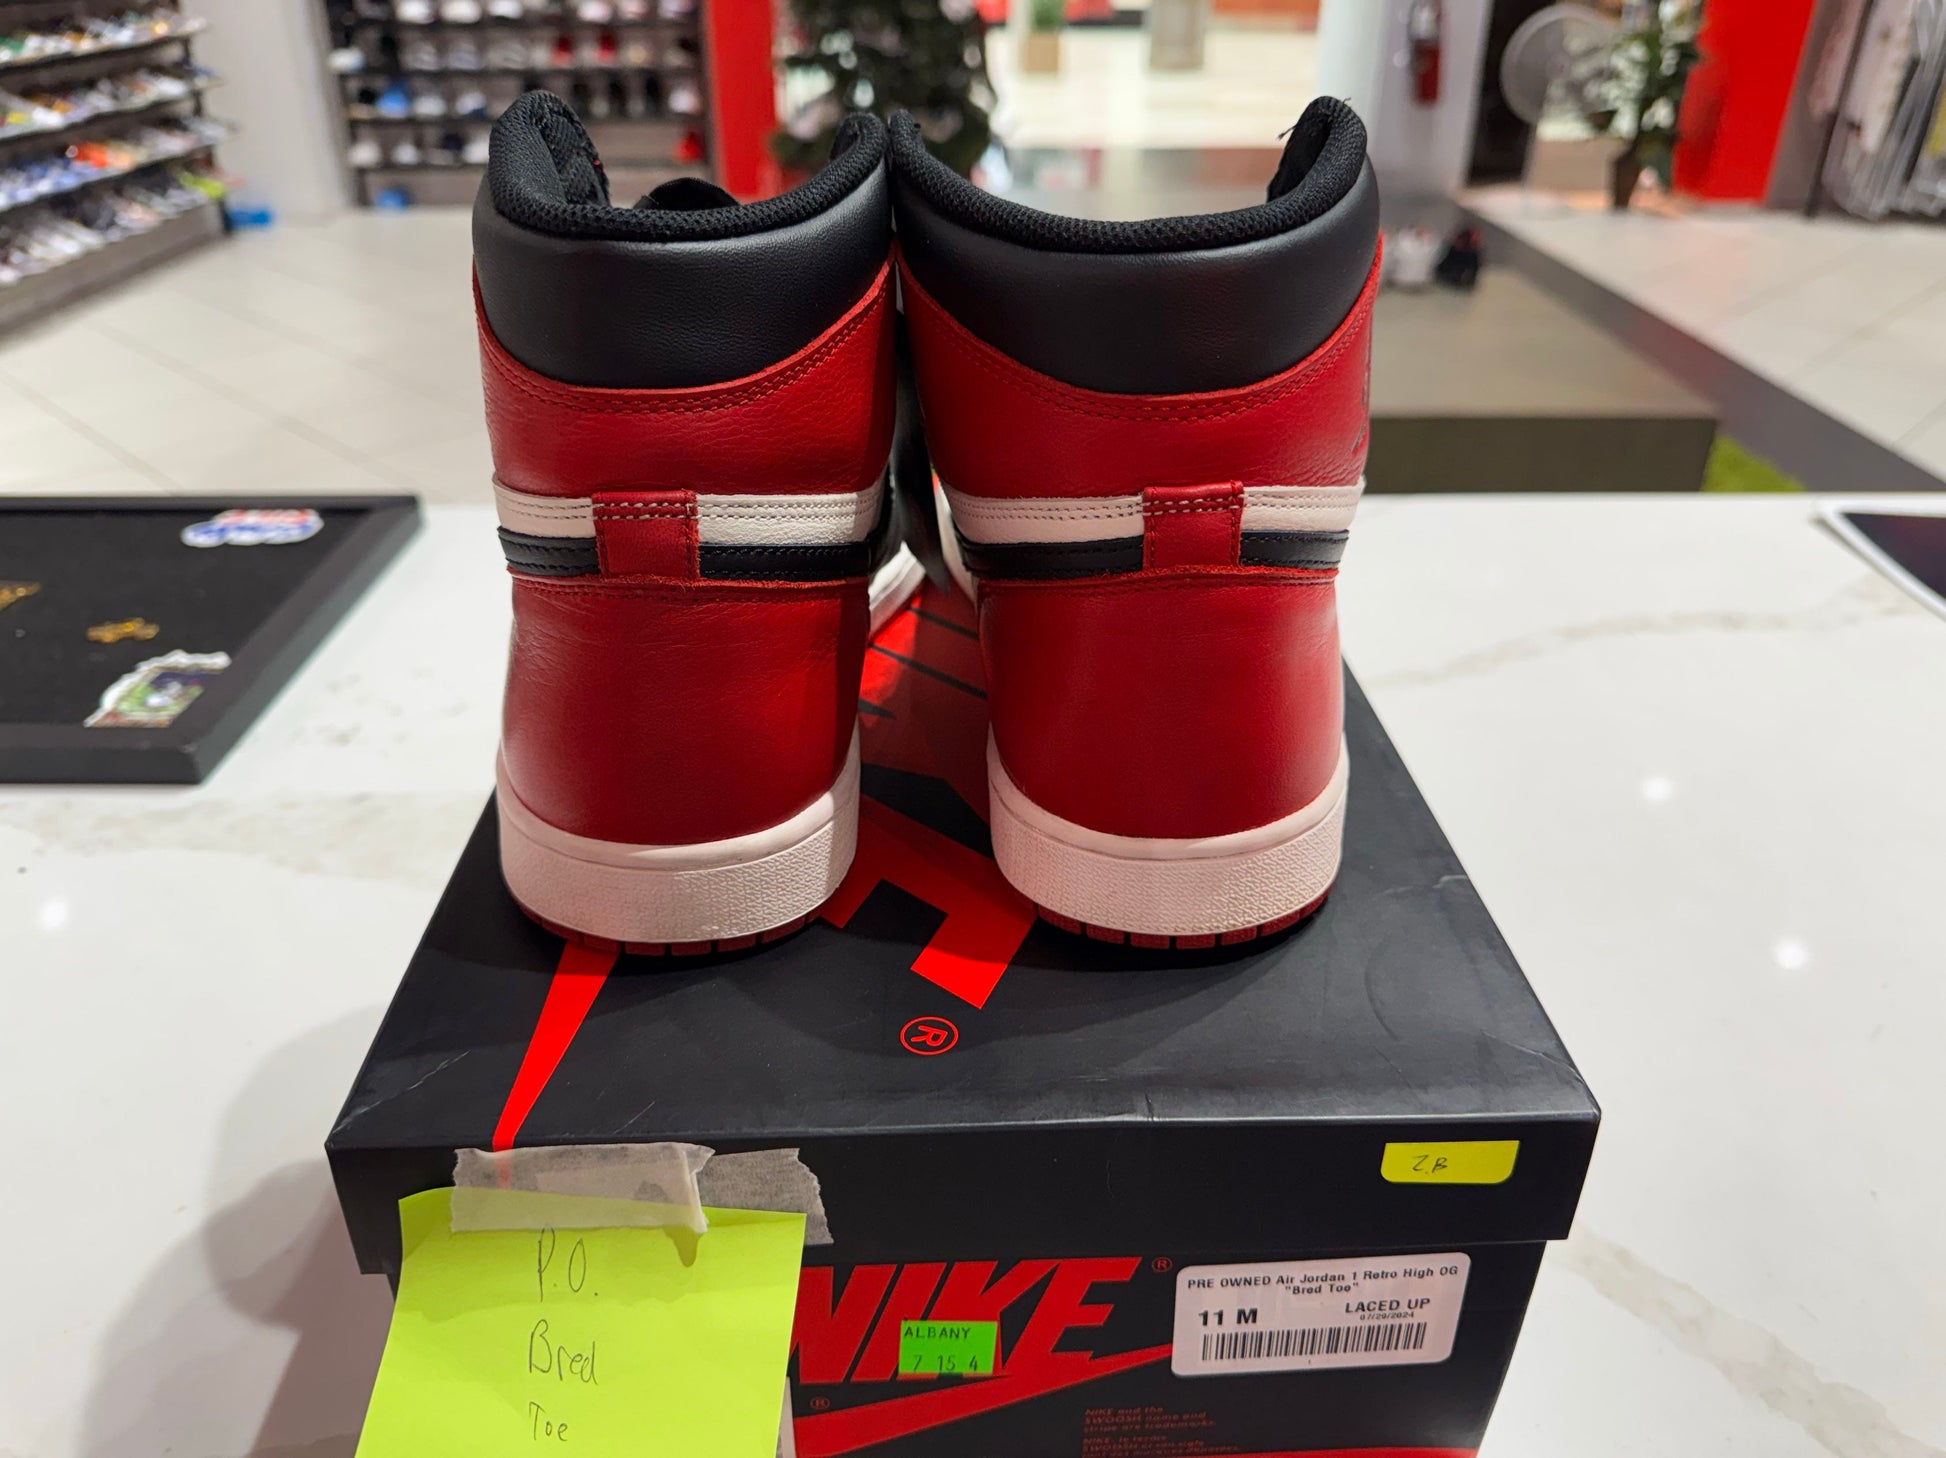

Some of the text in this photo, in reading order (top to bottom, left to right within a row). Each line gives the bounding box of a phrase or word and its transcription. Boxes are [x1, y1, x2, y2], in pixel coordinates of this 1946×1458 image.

[1187, 1265, 1458, 1289] PRE OWNED Air Jordan 1 Retro High OG
[1345, 1297, 1431, 1313] LACED UP
[787, 1256, 1143, 1384] NIKE
[1199, 1307, 1258, 1326] 11 M
[904, 1326, 971, 1339] ALBANY
[528, 1318, 599, 1386] Bred
[913, 1354, 923, 1373] 7
[969, 1354, 979, 1373] 4
[528, 1400, 569, 1443] Toe
